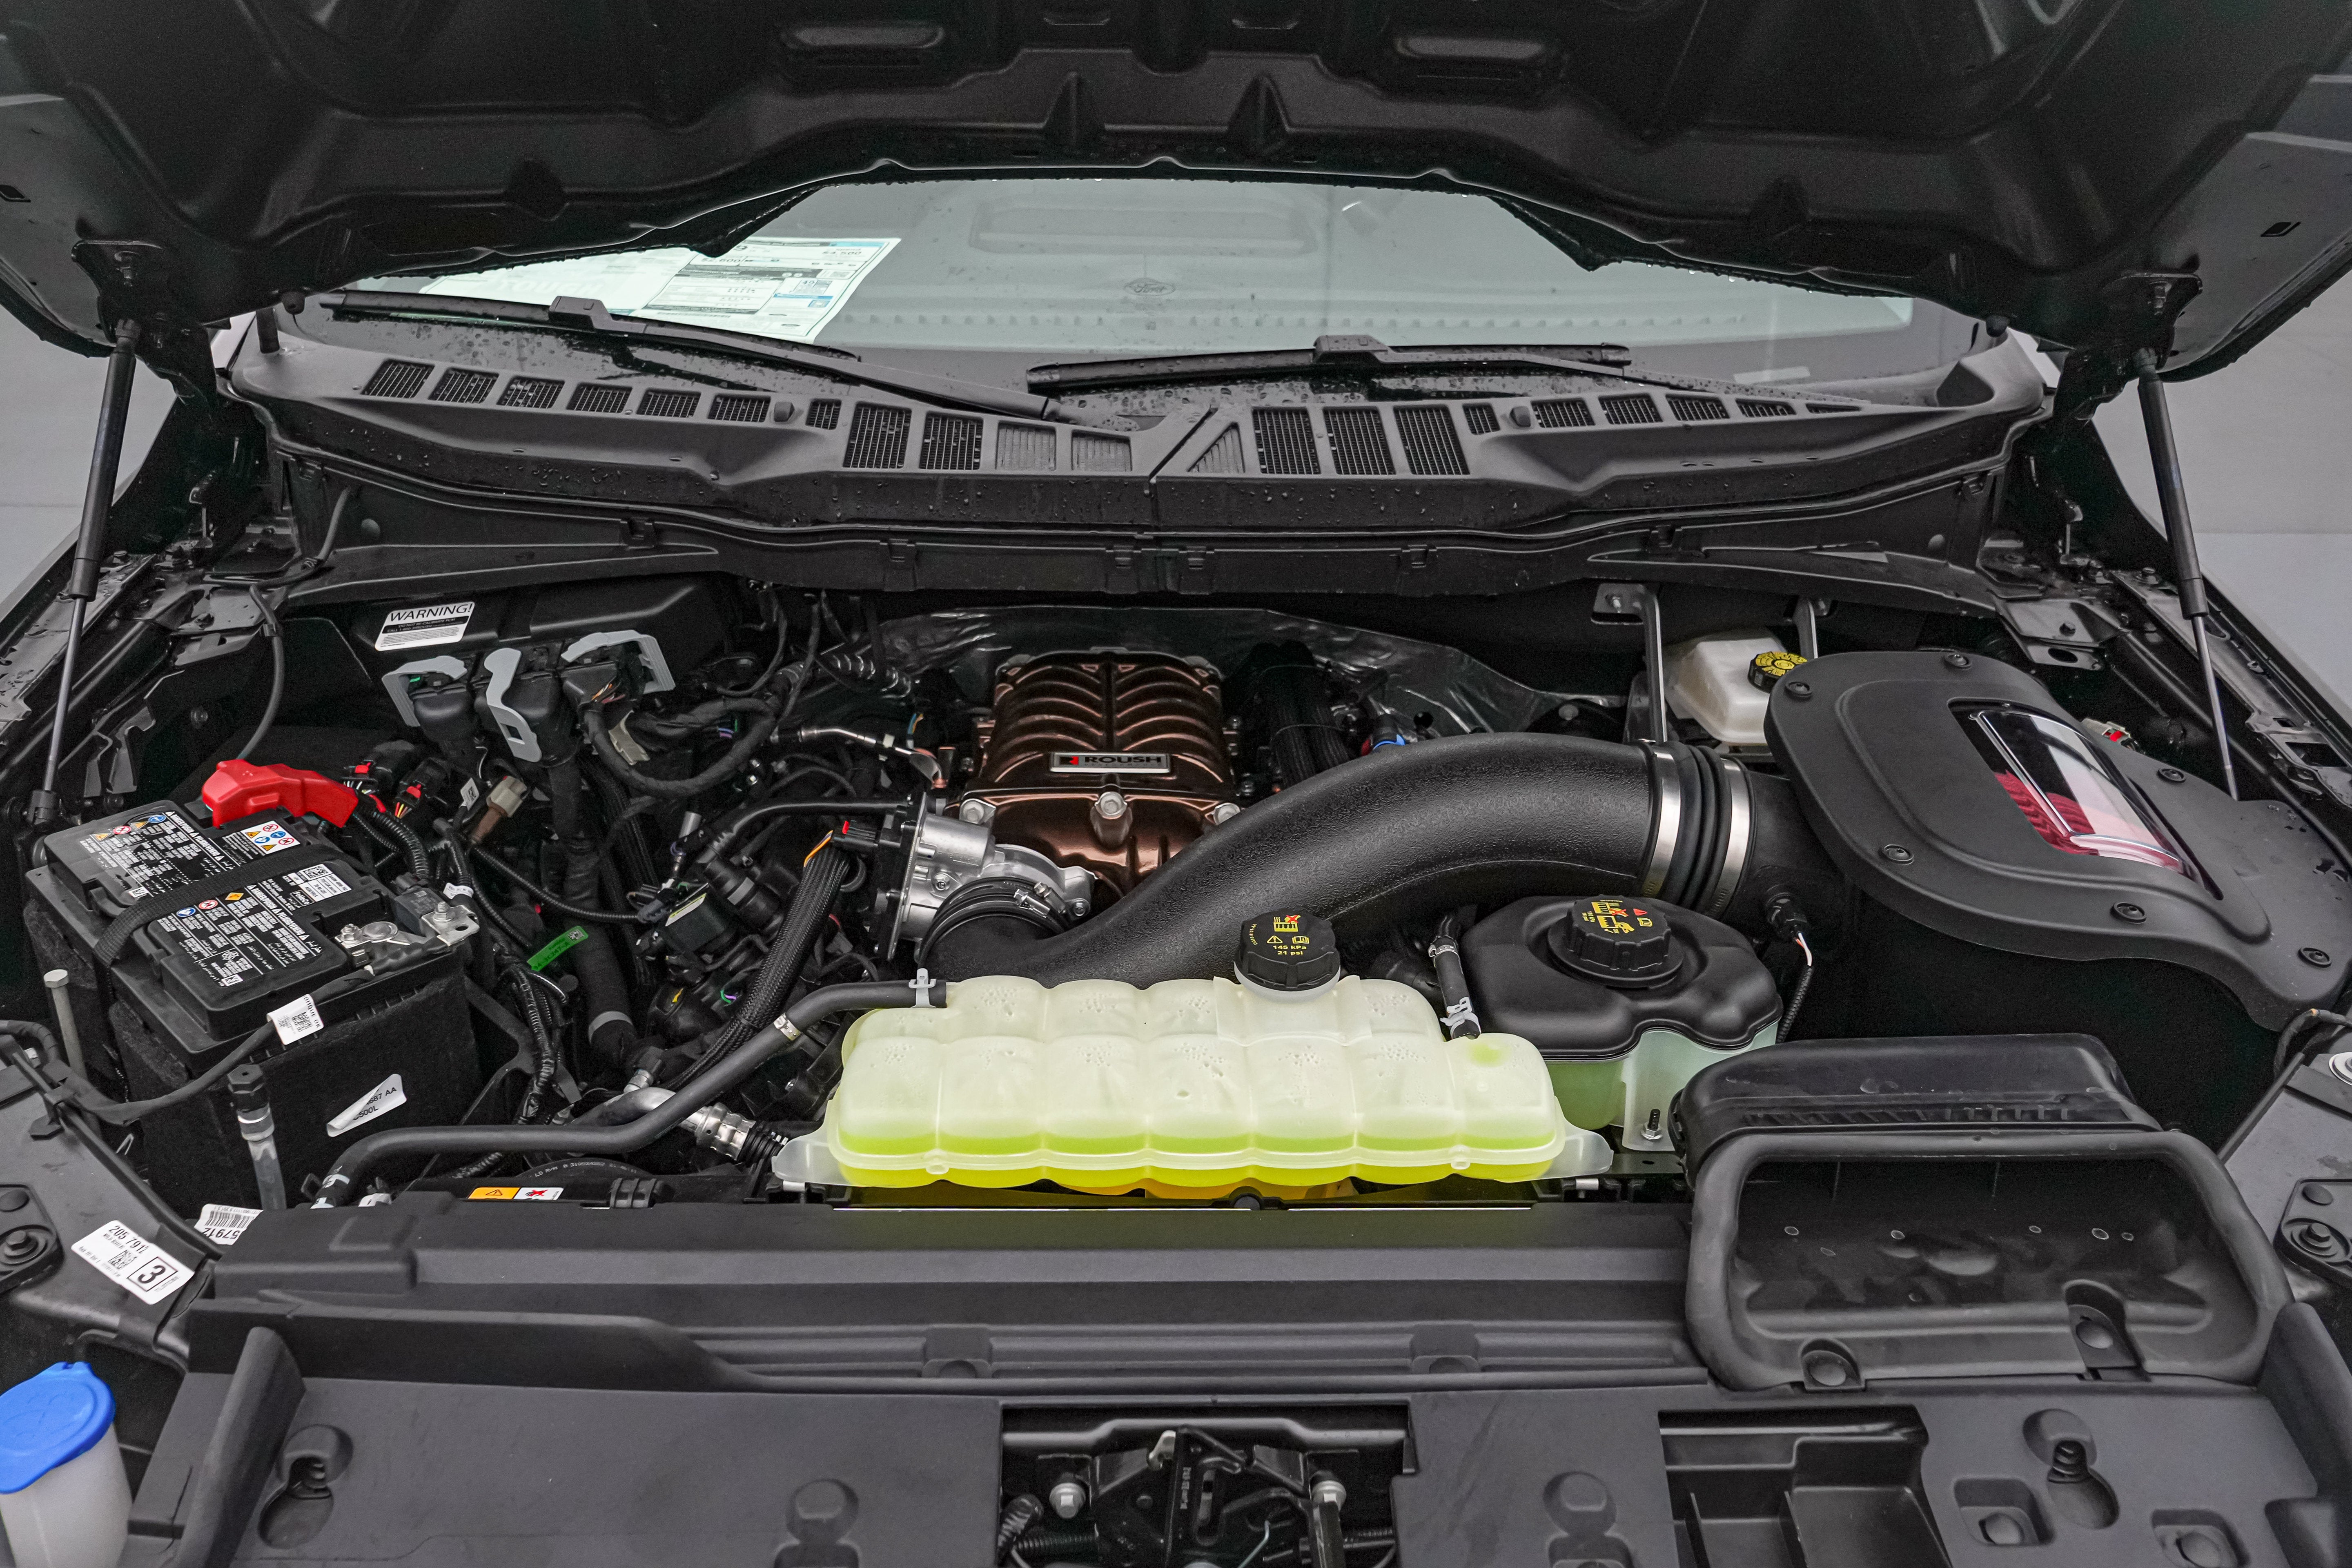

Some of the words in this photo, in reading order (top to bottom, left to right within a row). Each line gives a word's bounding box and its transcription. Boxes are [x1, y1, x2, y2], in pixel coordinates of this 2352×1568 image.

[391, 603, 473, 621] WARNING!
[293, 891, 310, 905] FoMoCo
[314, 1019, 321, 1028] OK
[366, 1093, 383, 1105] 687
[385, 1087, 397, 1096] AA
[108, 1225, 129, 1240] 205
[126, 1237, 150, 1254] 7912
[138, 1265, 166, 1284] 3
